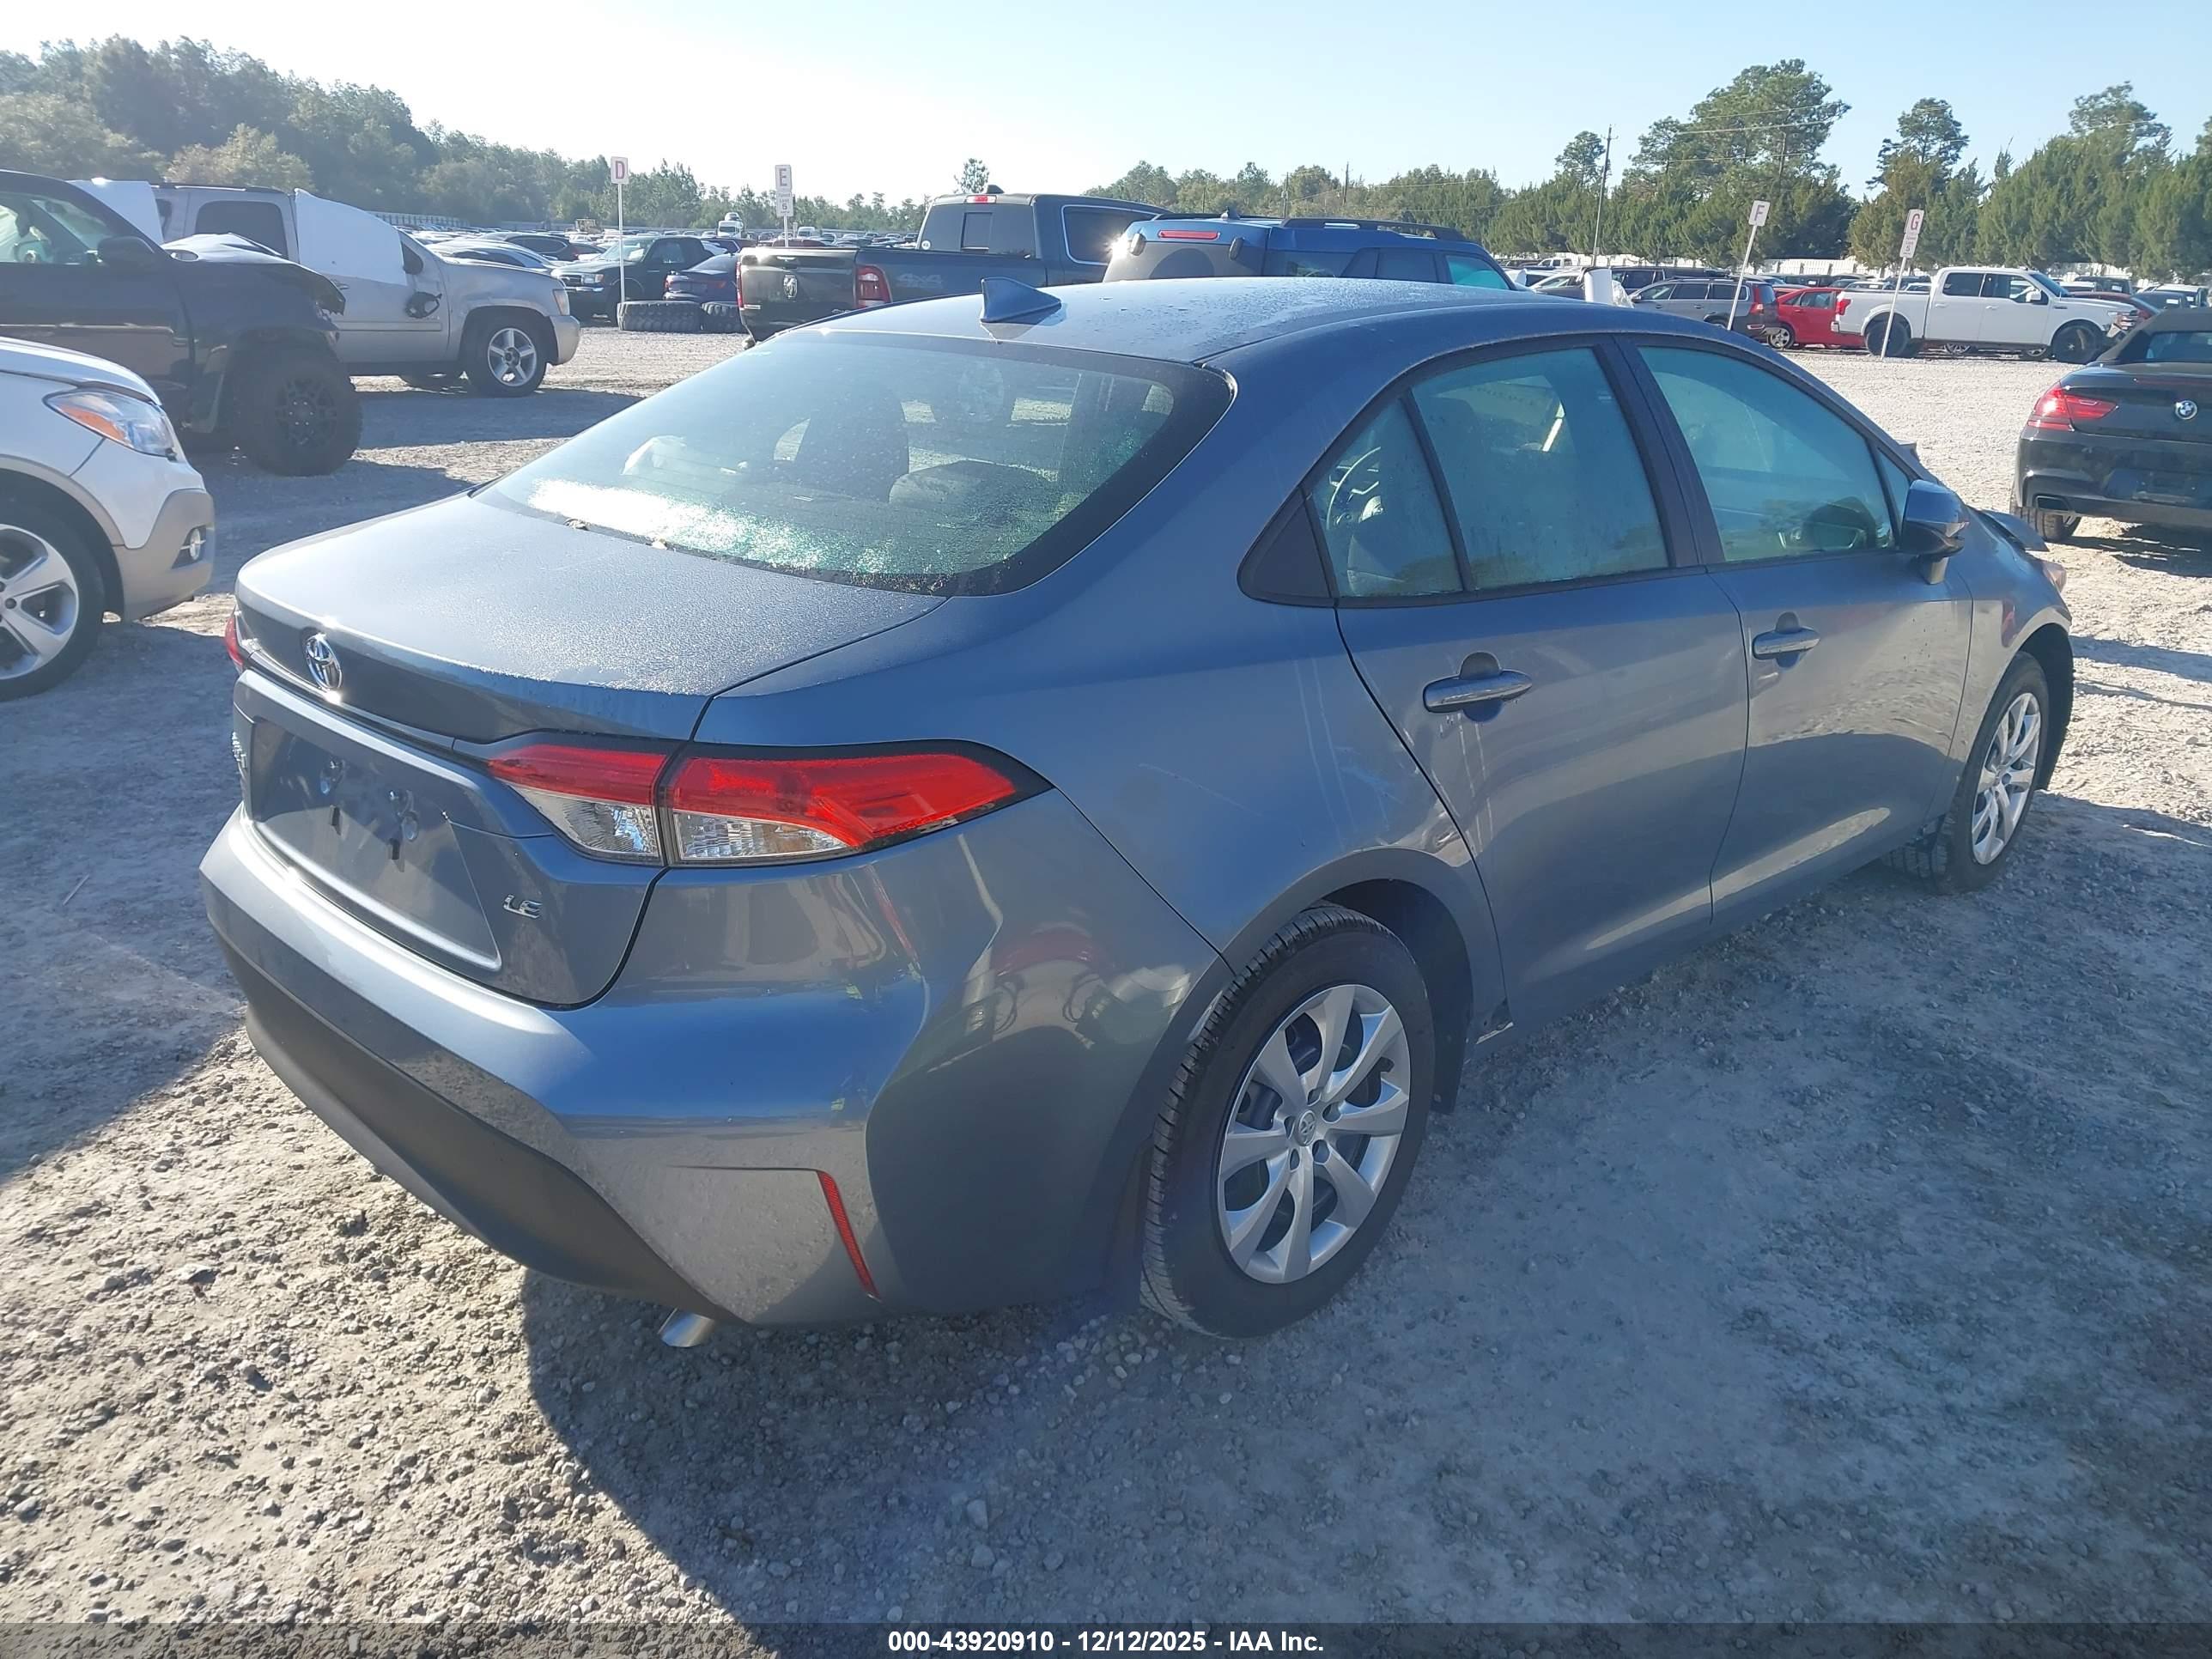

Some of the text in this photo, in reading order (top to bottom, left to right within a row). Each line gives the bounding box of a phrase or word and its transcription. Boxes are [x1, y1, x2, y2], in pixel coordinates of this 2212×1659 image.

[615, 161, 625, 179] D
[779, 168, 787, 186] E
[1753, 204, 1765, 221] F
[1911, 213, 1920, 230] G
[503, 894, 543, 919] LE
